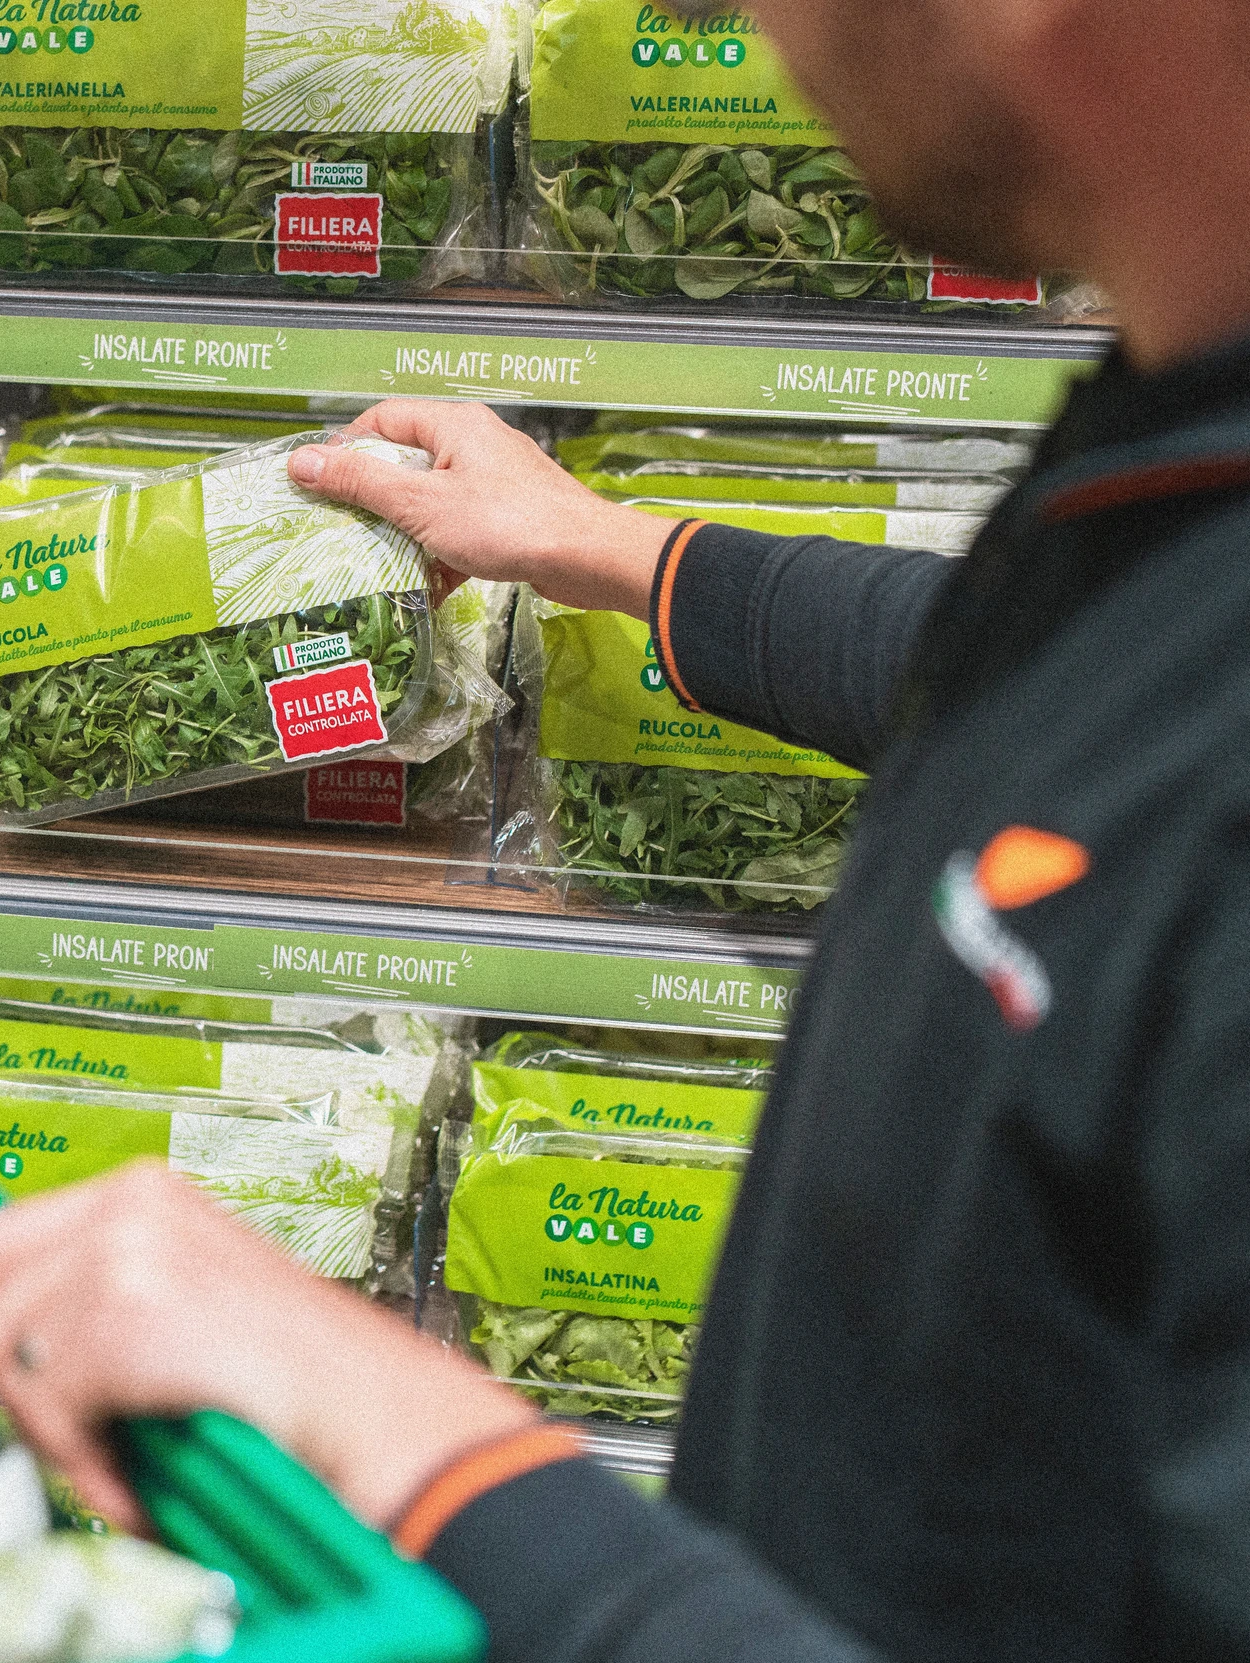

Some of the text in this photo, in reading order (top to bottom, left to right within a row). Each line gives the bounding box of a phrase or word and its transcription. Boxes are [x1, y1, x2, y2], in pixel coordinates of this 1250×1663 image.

[31, 0, 142, 24] Natura
[635, 4, 763, 37] la Natu
[636, 42, 741, 63] VALE
[42, 101, 80, 114] lavato
[80, 105, 88, 114] e
[87, 103, 129, 117] pronto
[129, 105, 151, 118] per
[151, 102, 163, 115] il
[163, 104, 218, 115] consumo
[630, 96, 778, 114] VALERIANELLA
[626, 116, 683, 131] prodotto
[684, 116, 726, 130] lavato
[728, 121, 736, 129] e
[735, 118, 781, 134] pronto
[781, 121, 804, 134] per
[313, 166, 363, 175] PRODOTTO
[313, 175, 364, 186] ITALIANO
[288, 216, 374, 236] FILIERA
[286, 240, 372, 253] CONTROLLATA
[94, 333, 274, 371] INSALATE PRONTE
[395, 347, 583, 385] INSALATE PRONTE
[777, 363, 973, 402] INSALATE PRONTE
[6, 533, 111, 569] Natura
[28, 639, 64, 658] lavato
[65, 638, 72, 648] e
[72, 631, 110, 651] pronto
[110, 625, 130, 642] per
[130, 619, 141, 634] il
[140, 611, 193, 631] consumo
[295, 636, 344, 654] PRODOTTO
[297, 646, 346, 665] ITALIANO
[283, 686, 369, 721] FILIERA
[288, 709, 373, 737] CONTROLLATA
[639, 719, 722, 740] RUCOLA
[634, 740, 692, 755] prodotto
[694, 742, 737, 757] lavato
[738, 749, 745, 757] e
[745, 747, 791, 762] pronto
[791, 751, 815, 765] per
[816, 751, 829, 763] il
[317, 770, 398, 790] FILIERA
[316, 791, 397, 804] CONTROLLATA
[52, 932, 215, 972] INSALATE PRON
[273, 944, 458, 987] INSALATE PRONTE
[652, 973, 803, 1012] INSALATE PRO
[28, 1047, 130, 1080] Natura
[607, 1103, 715, 1132] Natura
[549, 1182, 704, 1222] la Natura
[549, 1218, 649, 1245] VALE
[544, 1267, 660, 1292] INSALATINA
[540, 1287, 595, 1301] prodotto
[597, 1291, 638, 1306] lavato
[638, 1298, 645, 1306] e
[645, 1297, 688, 1311] pronto
